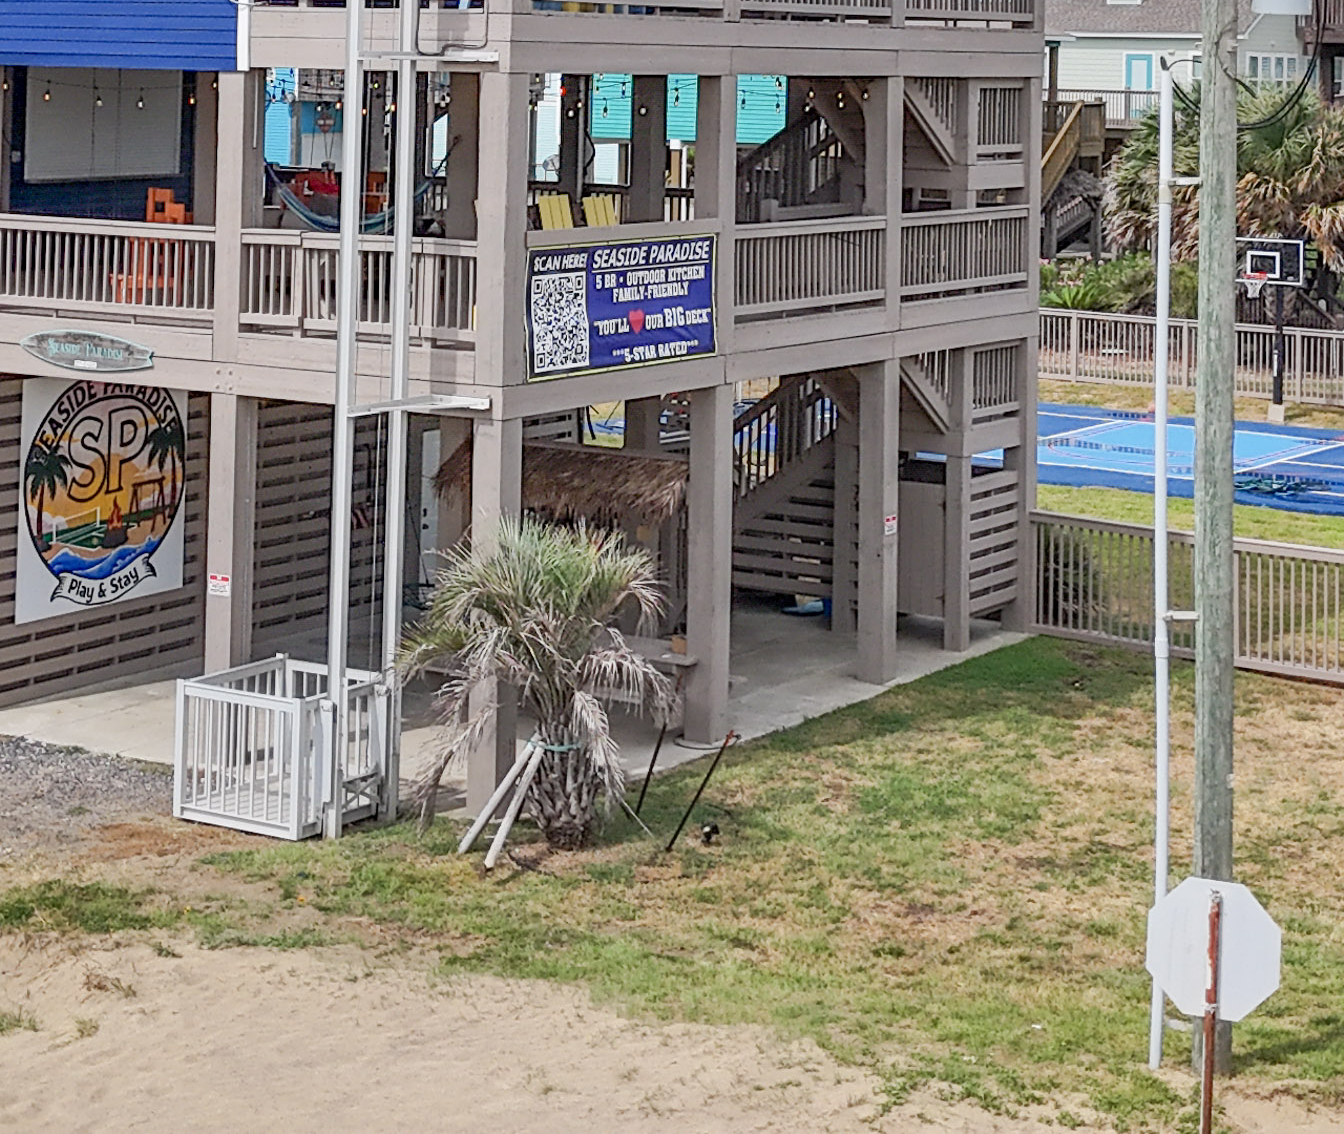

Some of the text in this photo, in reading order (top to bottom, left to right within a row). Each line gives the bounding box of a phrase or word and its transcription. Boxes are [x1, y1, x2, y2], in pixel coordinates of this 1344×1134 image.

[533, 253, 588, 272] SCAN HERE!
[592, 241, 710, 269] SEASIDE PARADISE
[595, 266, 705, 289] 5 BR OUTDOOR KITCHEN
[612, 282, 689, 303] FAMILY-FRIENDLY
[645, 317, 664, 329] OUR
[664, 307, 685, 328] BIG
[68, 405, 149, 501] SP
[67, 567, 139, 603] Play & Stay
